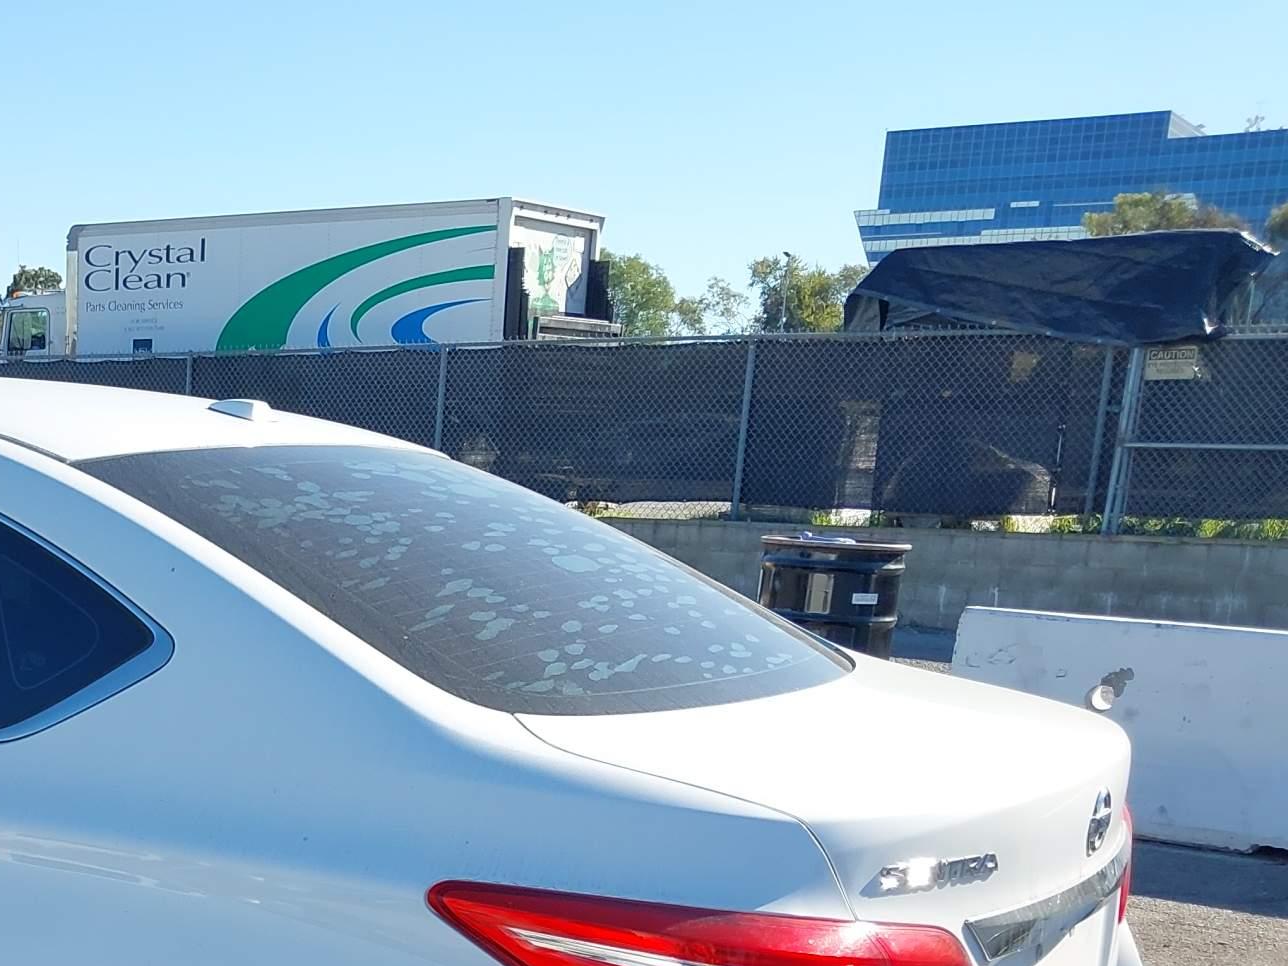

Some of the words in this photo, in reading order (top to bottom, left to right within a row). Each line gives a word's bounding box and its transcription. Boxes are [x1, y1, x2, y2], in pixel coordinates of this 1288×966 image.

[84, 237, 206, 273] Crystal
[84, 267, 187, 292] Clean
[85, 301, 106, 313] Parts
[108, 299, 146, 313] Cleaning
[147, 297, 184, 311] Services
[1150, 350, 1194, 360] CAUTION
[879, 852, 999, 889] SNTRA
